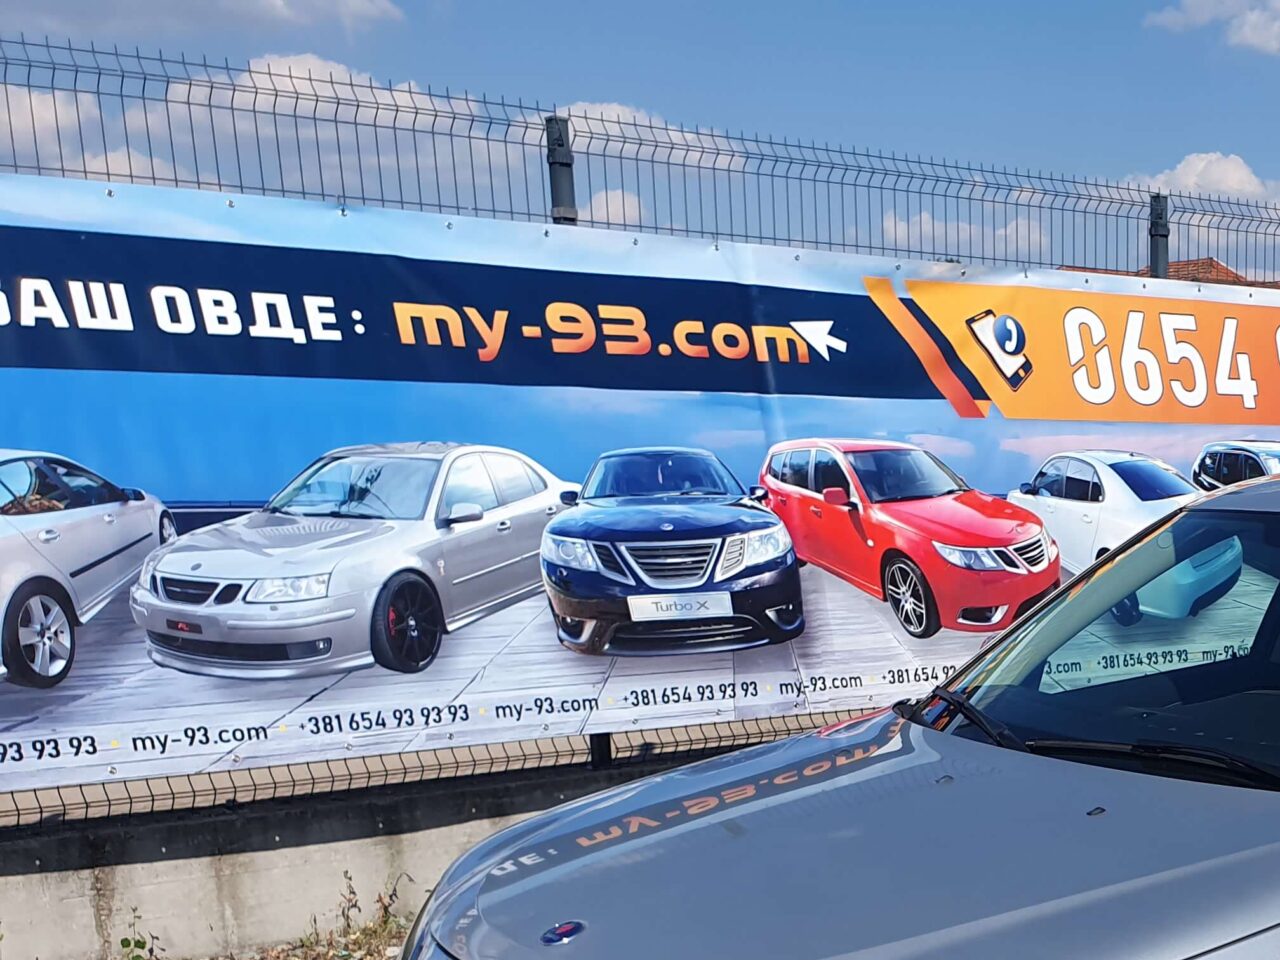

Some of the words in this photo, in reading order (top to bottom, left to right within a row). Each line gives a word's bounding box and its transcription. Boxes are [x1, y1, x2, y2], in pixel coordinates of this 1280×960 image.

[0, 276, 134, 332] АШ
[150, 285, 366, 344] ОВДЕ:
[393, 302, 811, 363] my-93.com
[1063, 307, 1258, 410] 0654
[651, 600, 693, 612] Turbo
[696, 600, 710, 611] X
[1097, 654, 1120, 670] +381
[1123, 652, 1143, 668] 654
[1146, 651, 1158, 666] 93
[1161, 650, 1174, 664] 93
[1176, 649, 1188, 662] 93
[32, 738, 61, 761] 93
[69, 735, 98, 756] 93
[132, 725, 268, 755] my-93.com
[299, 714, 343, 735] +381
[349, 711, 386, 731] 654
[393, 708, 415, 728] 93
[420, 706, 442, 726] 93
[449, 703, 469, 723] 93
[495, 696, 599, 722] my-93.com
[623, 688, 658, 707] +381
[661, 686, 692, 704] 654
[698, 684, 714, 701] 93
[719, 682, 736, 699] 93
[741, 680, 758, 697] 93
[779, 673, 863, 698] my-93.com
[881, 668, 910, 685] +381
[914, 666, 939, 682] 654
